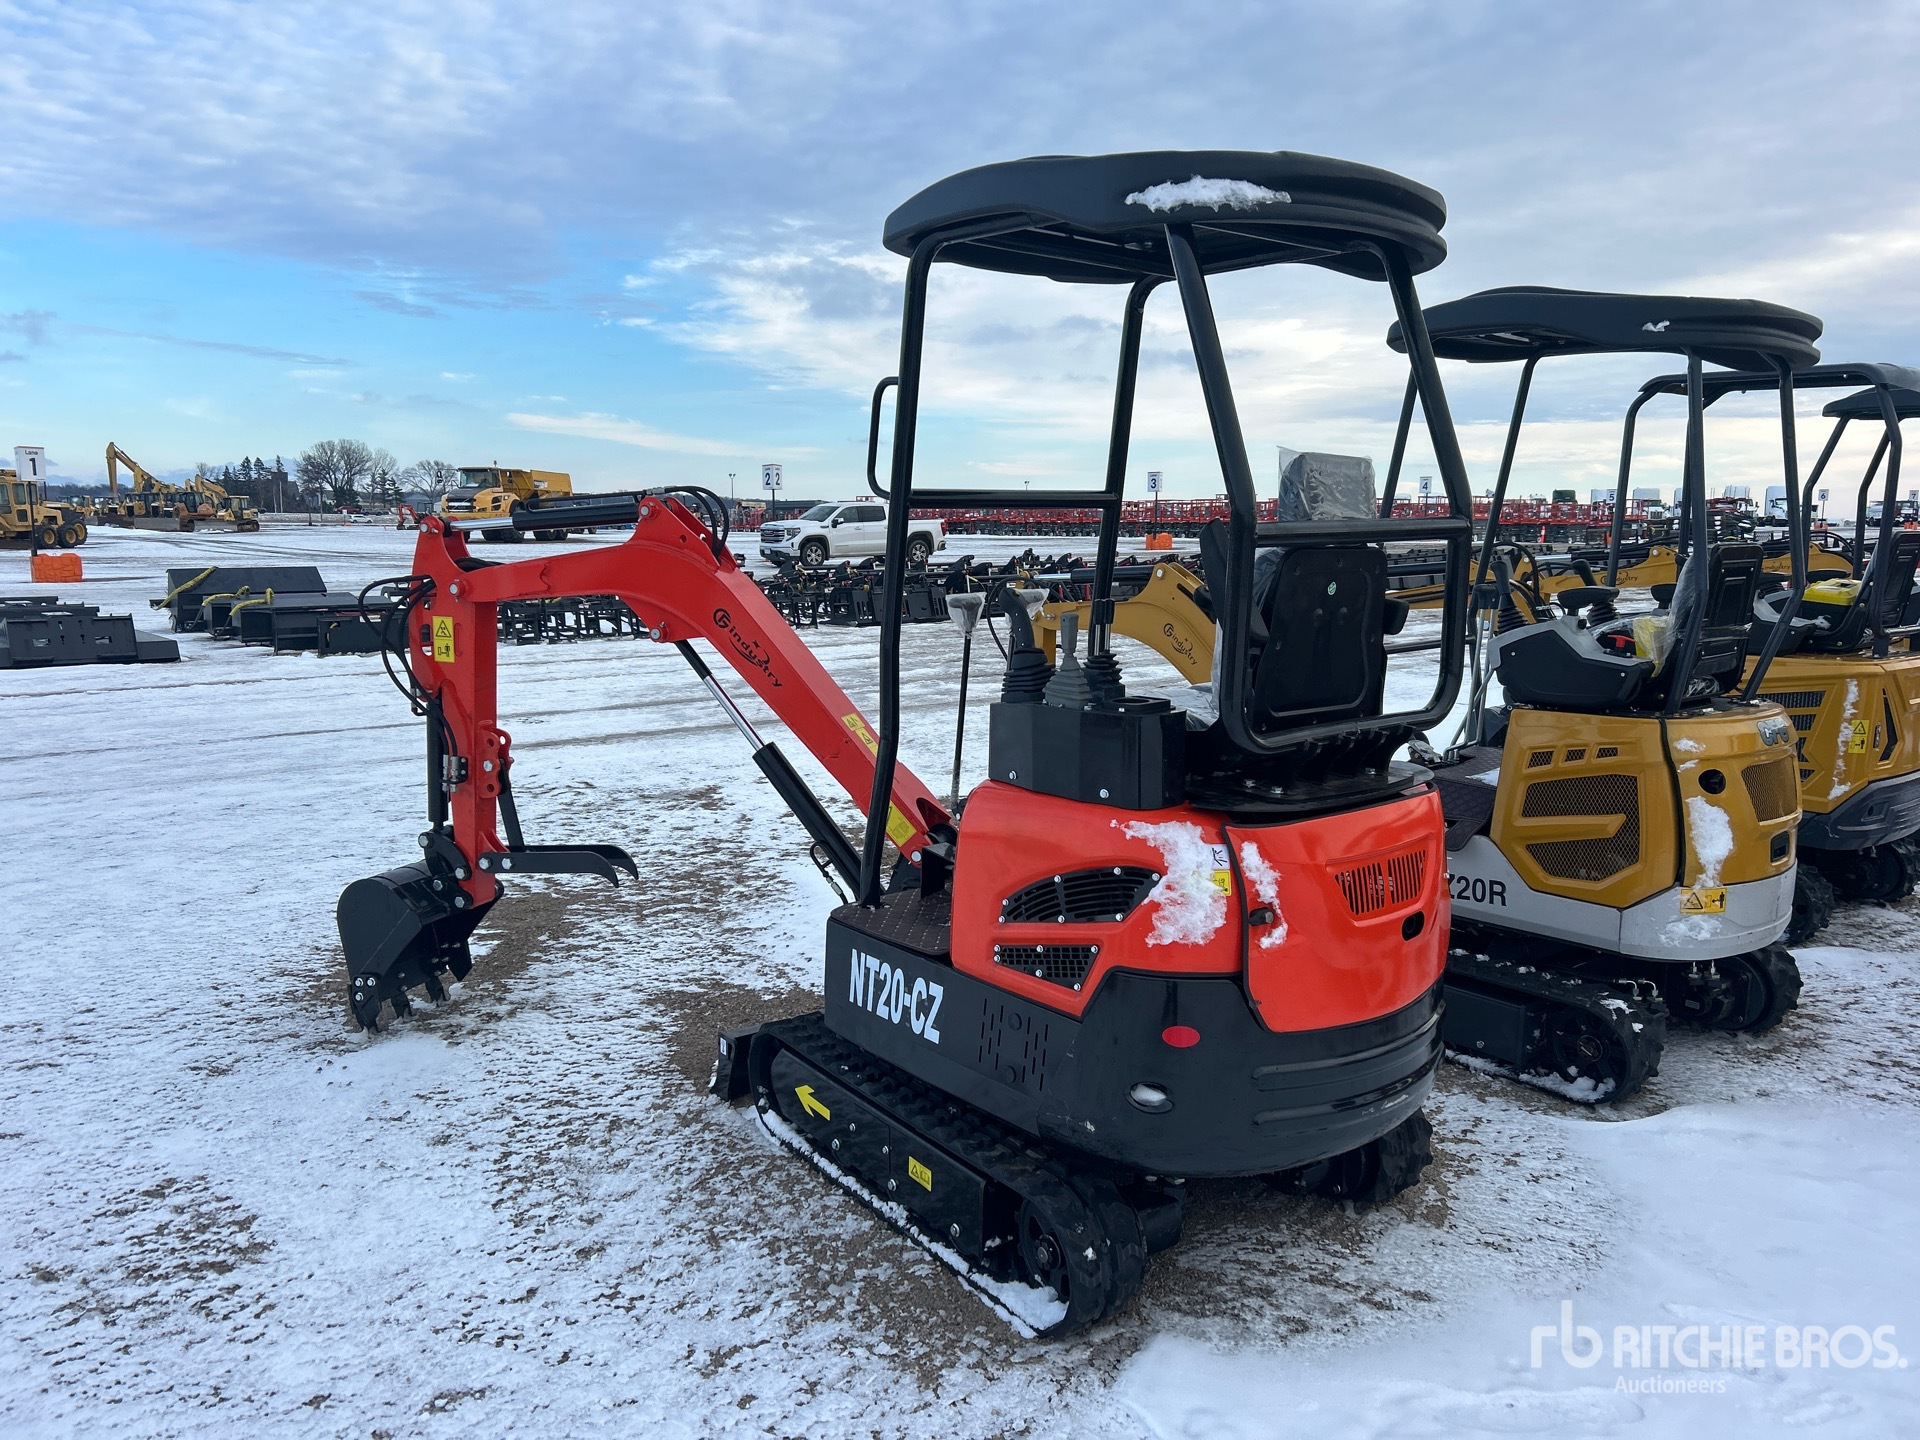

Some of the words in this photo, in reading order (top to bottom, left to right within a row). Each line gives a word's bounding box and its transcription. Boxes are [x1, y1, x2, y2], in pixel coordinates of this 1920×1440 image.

[29, 458, 37, 476] 1
[765, 472, 771, 485] 2
[775, 472, 780, 485] 2
[1150, 478, 1157, 489] 3
[1422, 481, 1428, 490] 4
[1609, 493, 1615, 501] 5
[849, 948, 944, 1045] NT20-CZ
